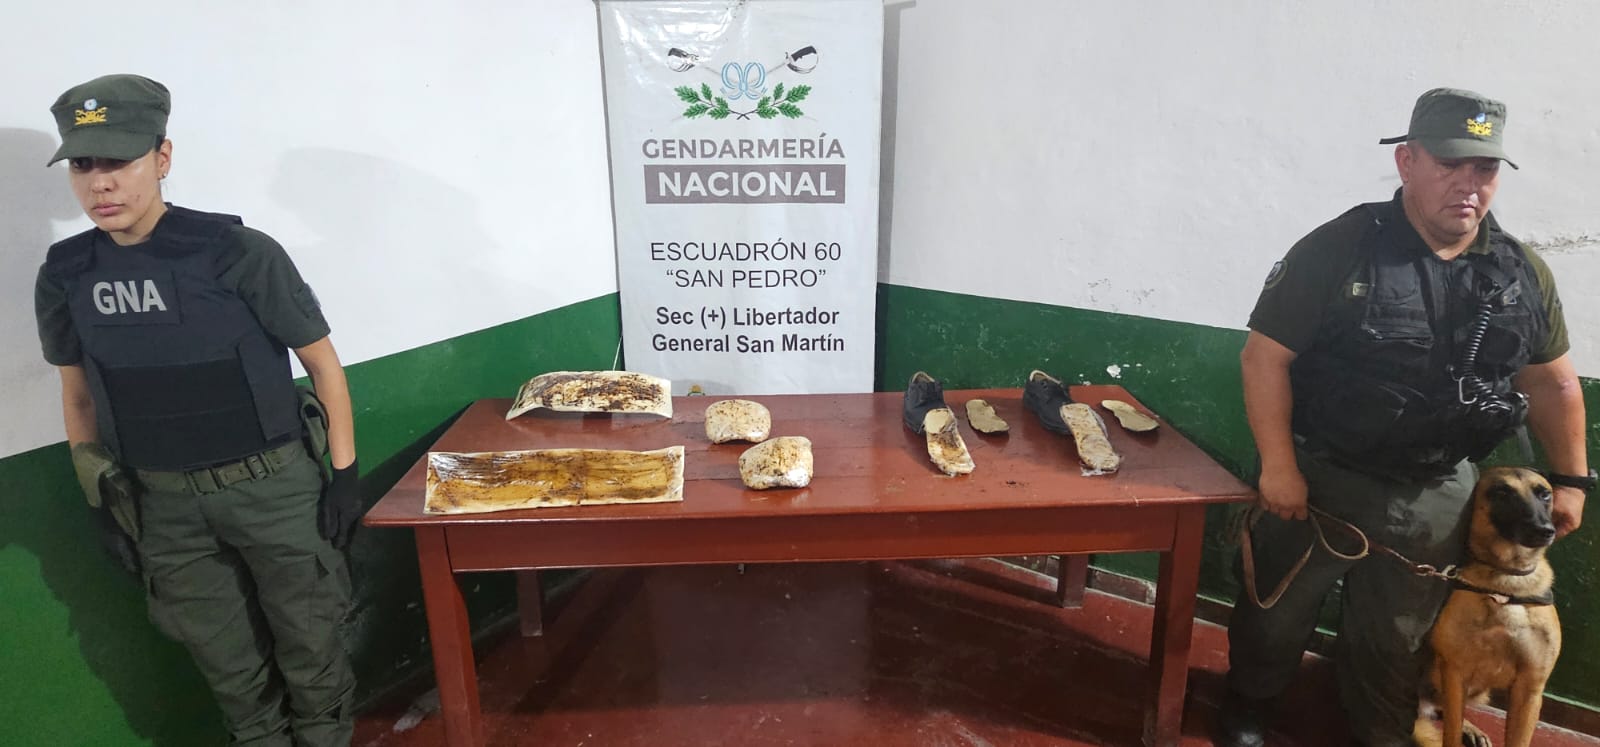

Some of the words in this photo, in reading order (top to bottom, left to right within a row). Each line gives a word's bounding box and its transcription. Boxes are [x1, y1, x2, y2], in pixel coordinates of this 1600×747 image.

[642, 132, 845, 159] GENDARMERÍA
[658, 171, 836, 197] NACIONAL
[650, 238, 806, 262] ESCUADRÓN
[814, 242, 842, 261] 60
[93, 279, 167, 315] GNA
[656, 306, 694, 325] Sec
[700, 307, 726, 330] (+)
[733, 306, 840, 326] Libertador
[652, 333, 730, 353] General
[736, 334, 775, 354] San
[782, 333, 845, 353] Martín
